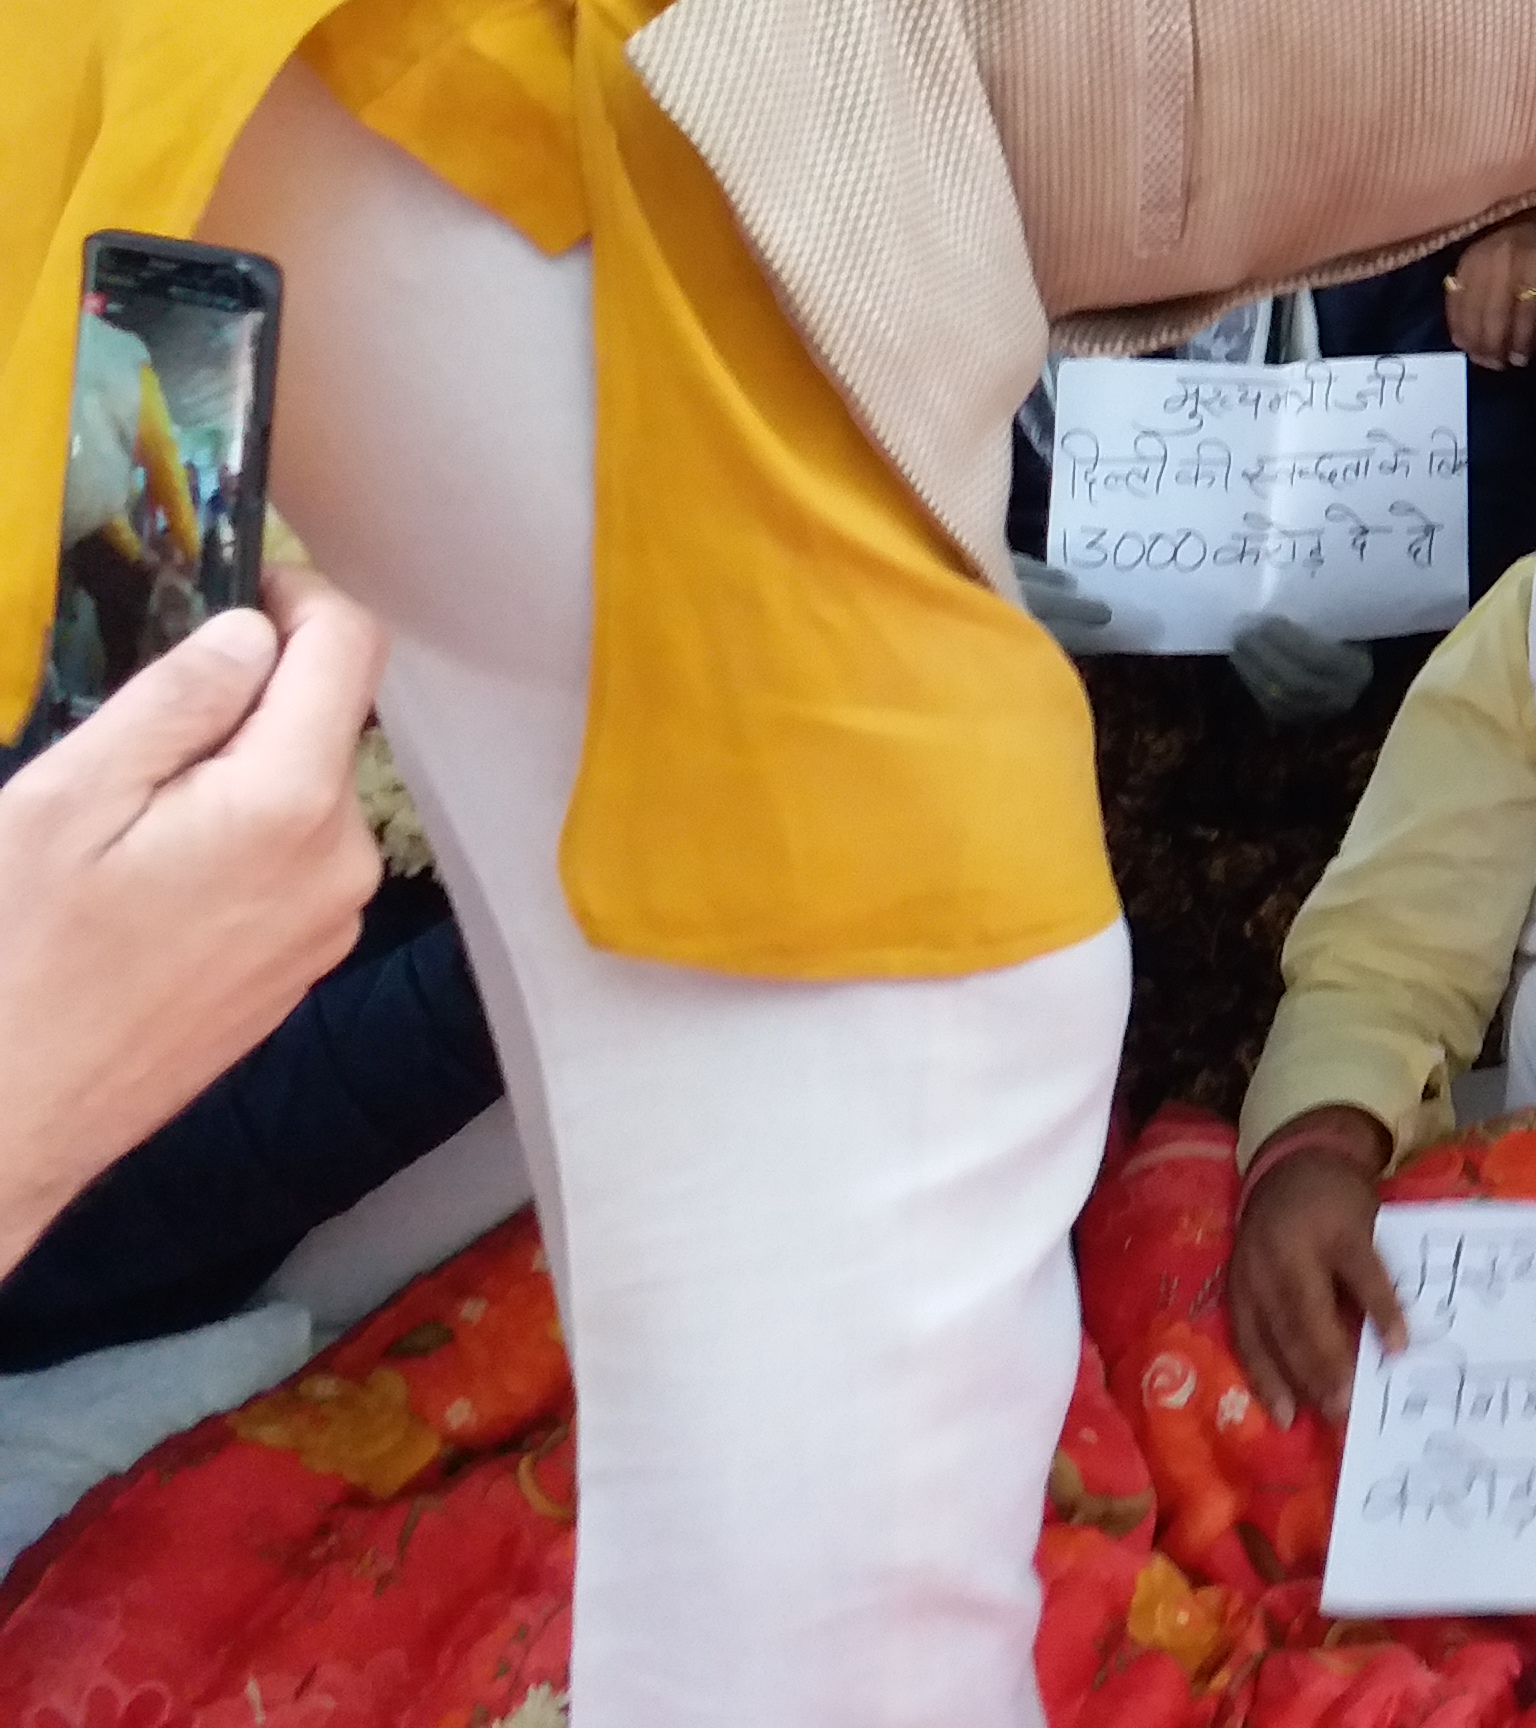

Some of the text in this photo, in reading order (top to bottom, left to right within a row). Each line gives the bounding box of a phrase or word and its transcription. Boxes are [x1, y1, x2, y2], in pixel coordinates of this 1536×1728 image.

[1061, 428, 1168, 504] दिल्ली
[1175, 437, 1233, 492] की
[1062, 526, 1208, 573] 13000
